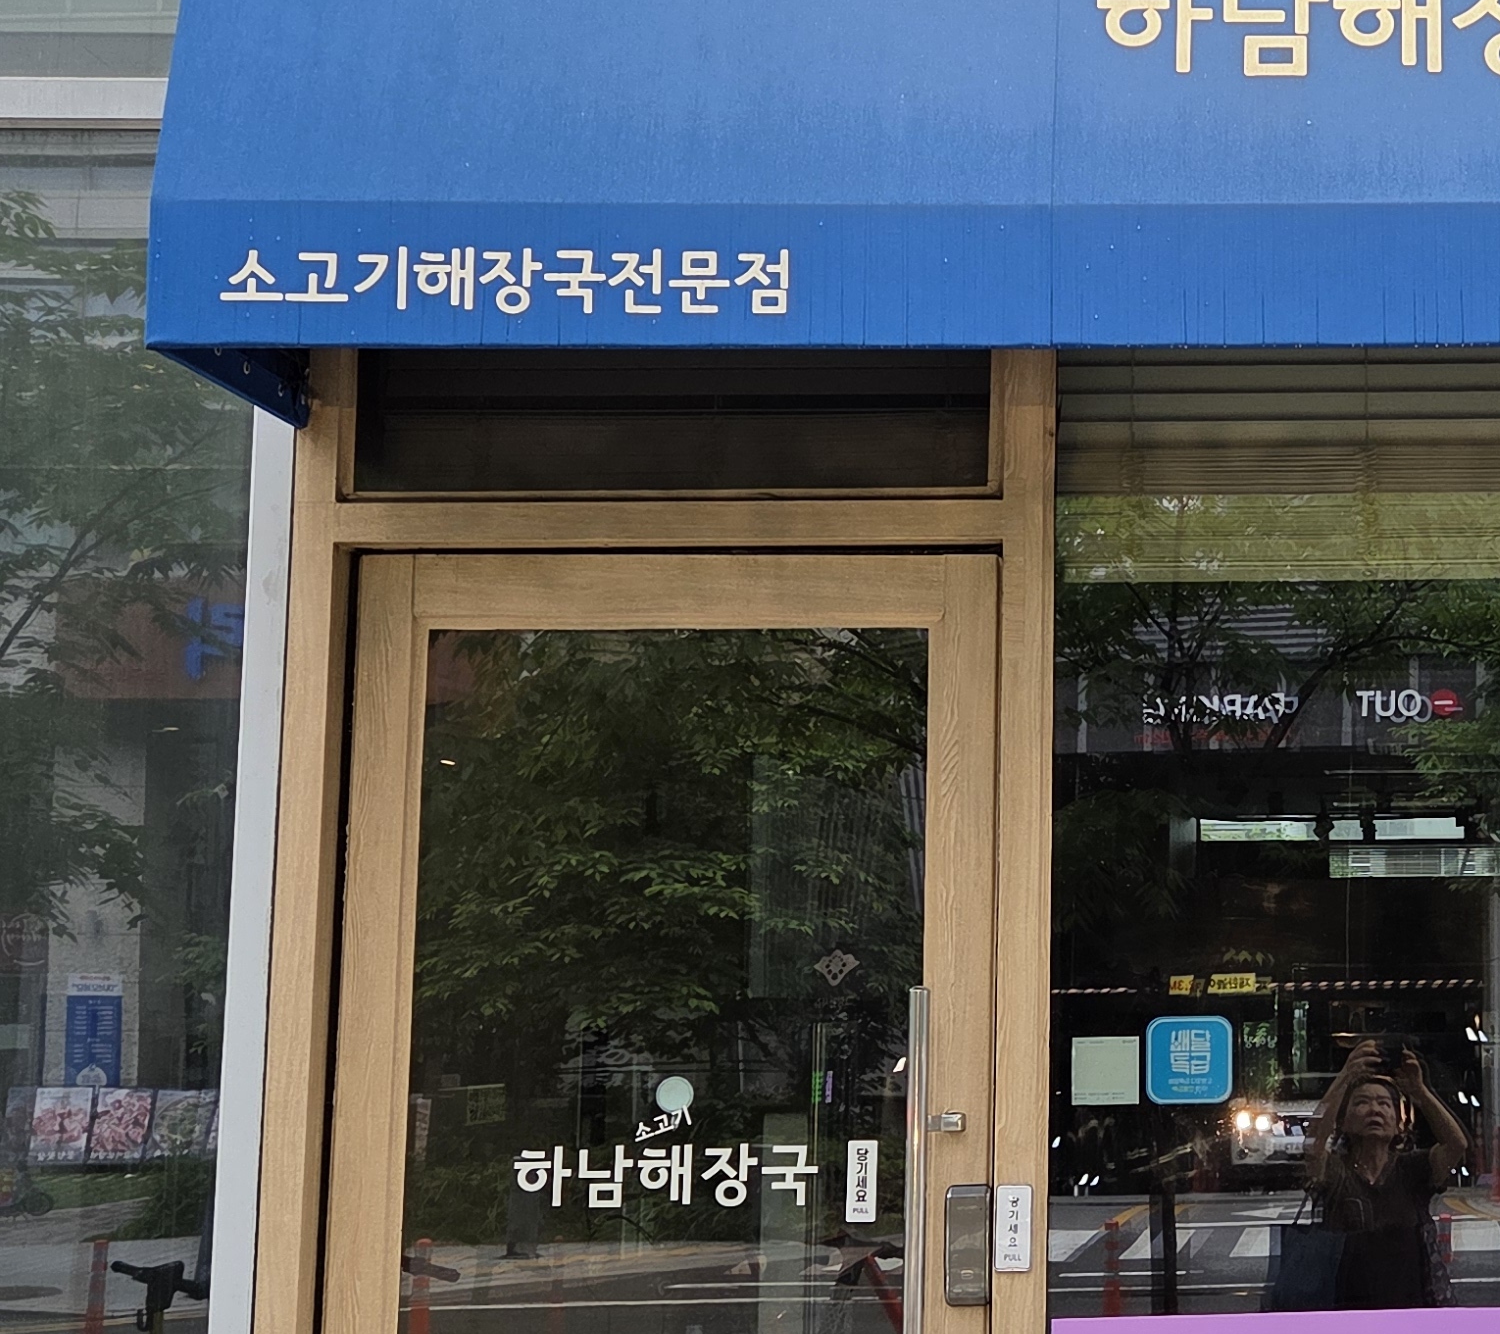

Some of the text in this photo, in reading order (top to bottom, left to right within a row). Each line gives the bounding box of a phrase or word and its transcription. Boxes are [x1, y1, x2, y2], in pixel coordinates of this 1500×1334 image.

[219, 245, 790, 315] 소고기해장국전문점
[634, 1105, 693, 1143] 소고기
[513, 1142, 820, 1209] 하남해장국
[855, 1148, 870, 1204] 당기세요
[1003, 1253, 1022, 1262] PULL
